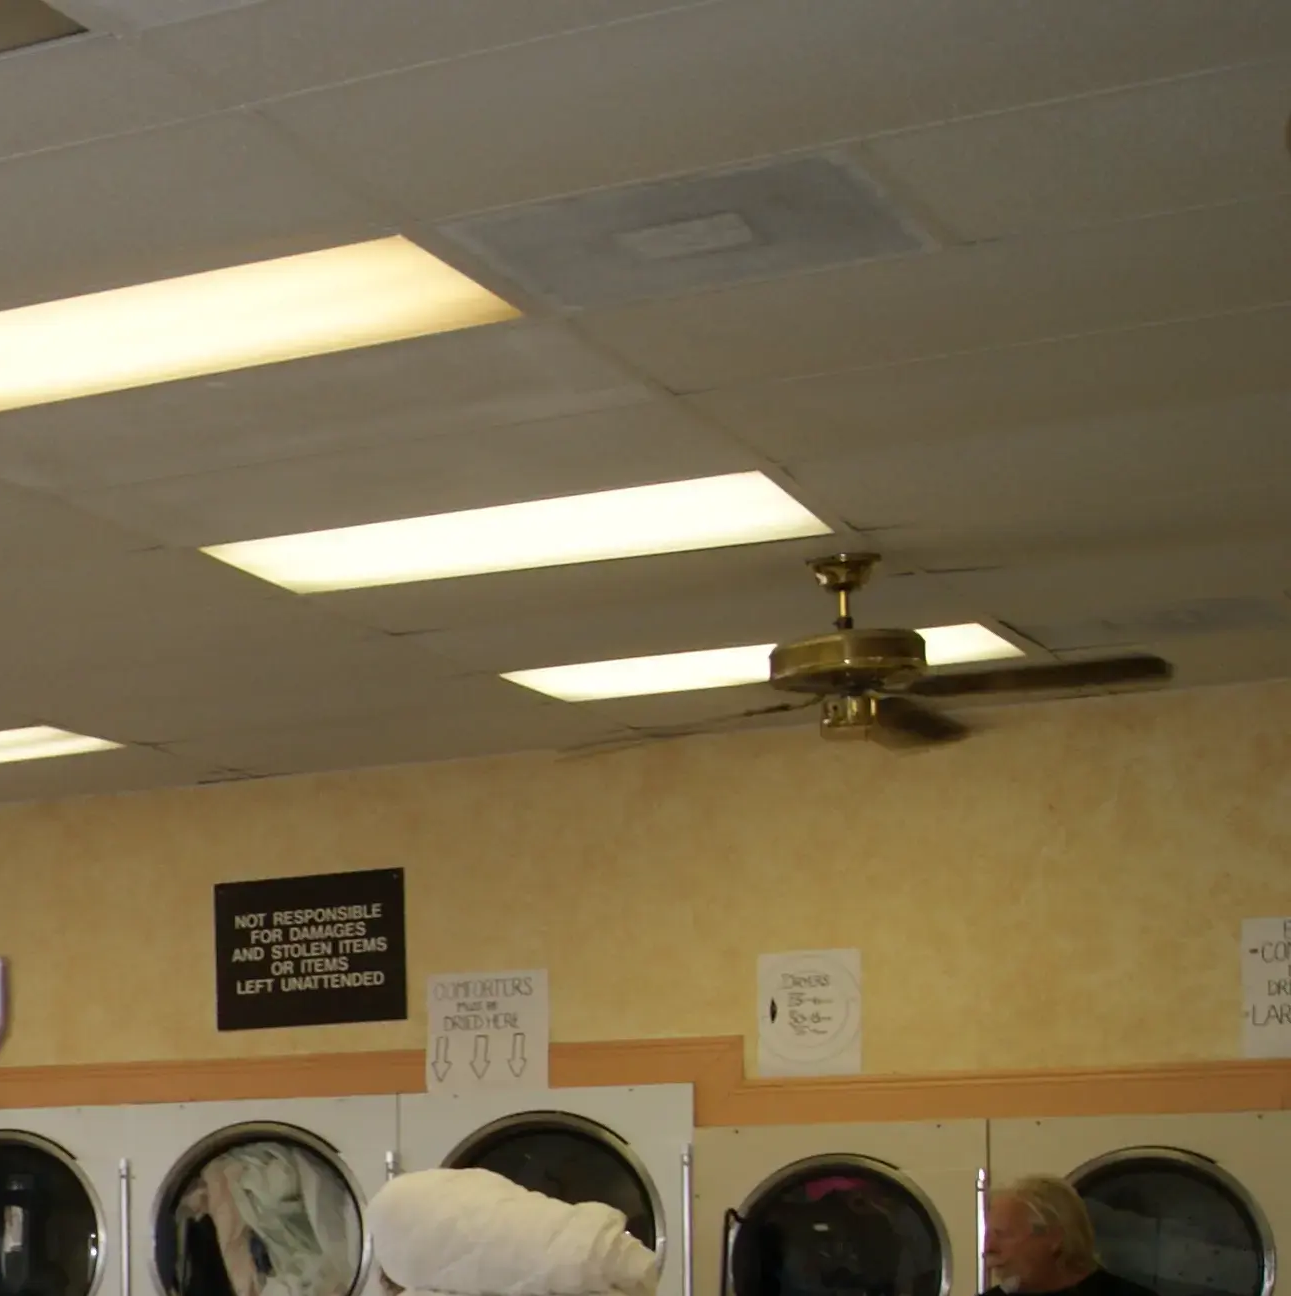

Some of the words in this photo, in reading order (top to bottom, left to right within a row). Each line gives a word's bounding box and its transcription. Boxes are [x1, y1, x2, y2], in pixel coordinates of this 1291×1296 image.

[234, 912, 267, 930] NOT
[272, 902, 383, 927] RESPONSIBLE
[250, 928, 283, 945] FOR
[289, 921, 367, 942] DAMAGES
[232, 946, 265, 963] AND
[271, 941, 332, 960] STOLEN
[338, 936, 389, 955] ITEMS
[271, 960, 294, 976] OR
[300, 956, 350, 974] ITEMS
[236, 978, 274, 995] LEFT
[280, 970, 385, 993] UNATTENDED
